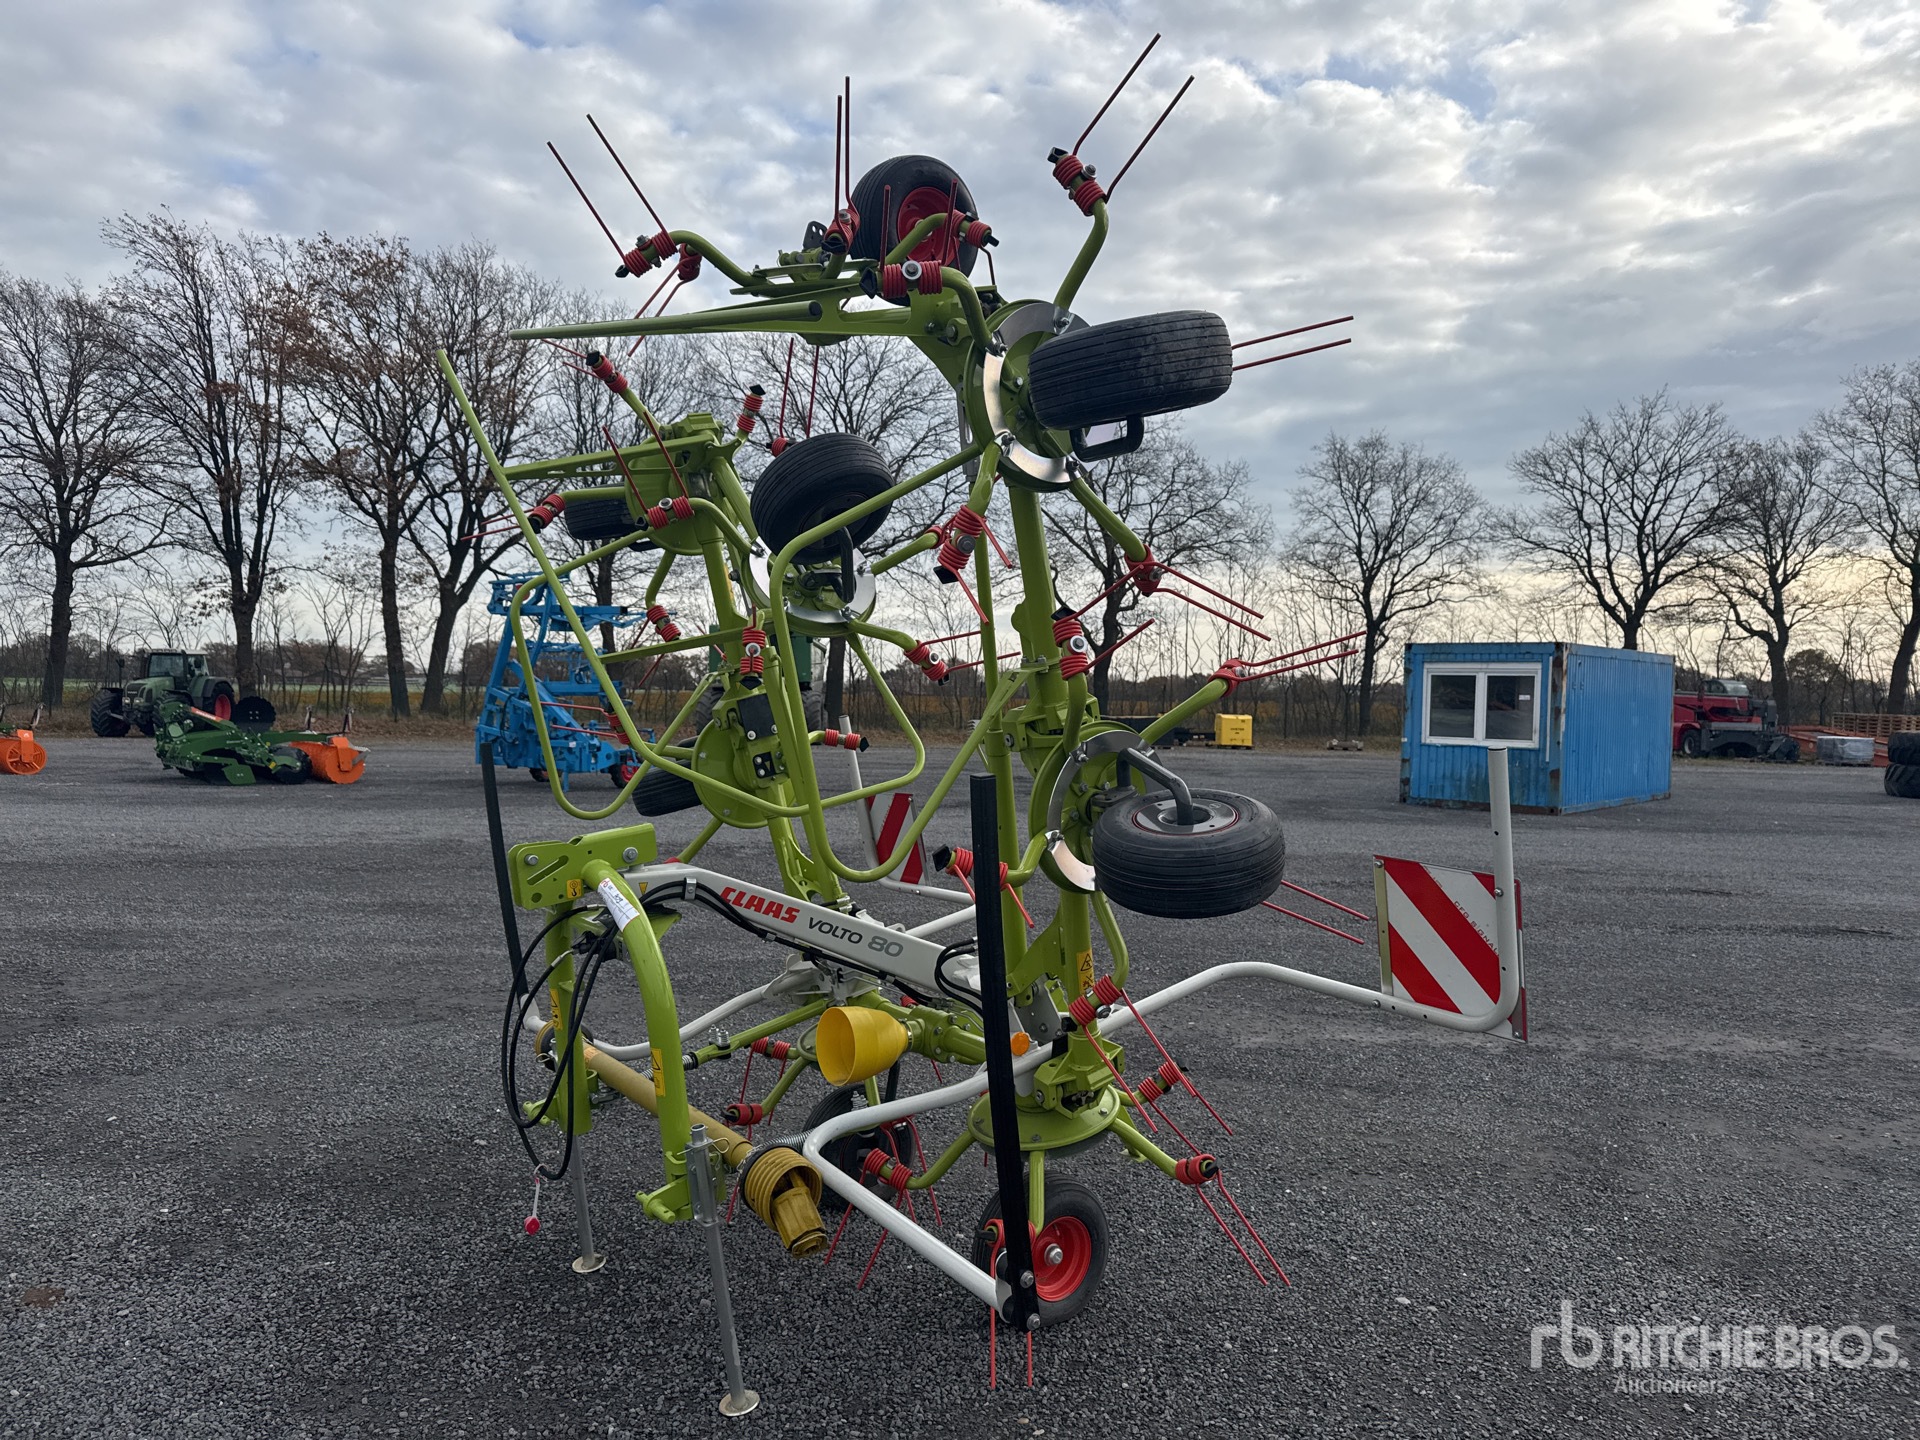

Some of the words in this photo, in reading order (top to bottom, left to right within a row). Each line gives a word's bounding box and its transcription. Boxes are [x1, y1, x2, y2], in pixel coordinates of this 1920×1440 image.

[720, 887, 800, 923] CLAAS
[808, 917, 863, 944] VOLTO
[868, 935, 904, 958] 80
